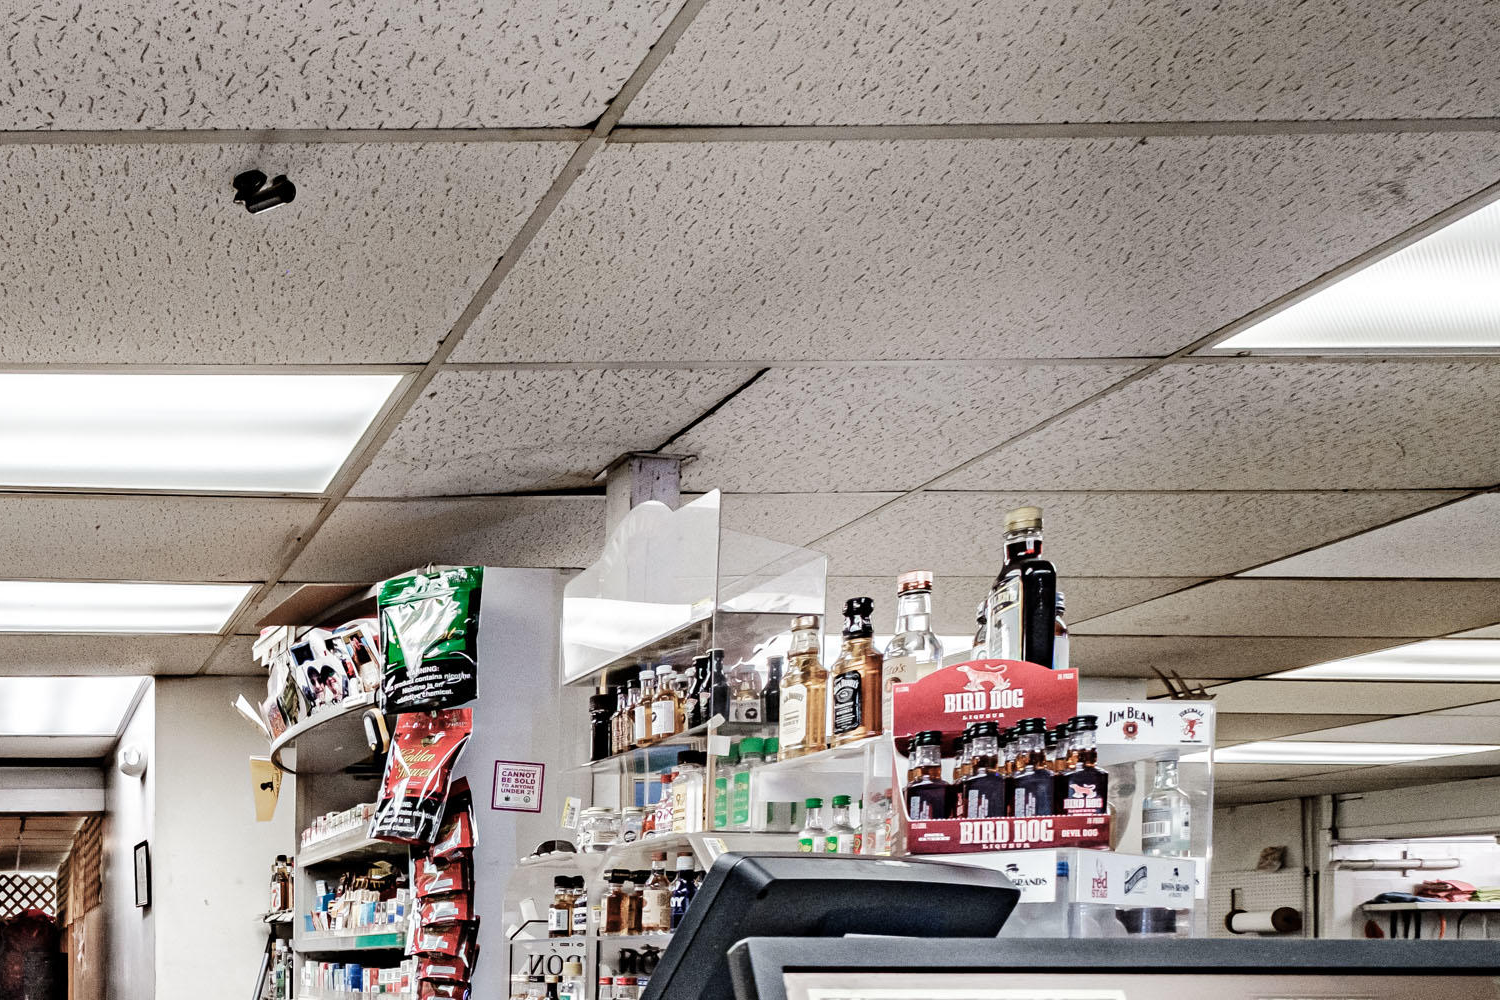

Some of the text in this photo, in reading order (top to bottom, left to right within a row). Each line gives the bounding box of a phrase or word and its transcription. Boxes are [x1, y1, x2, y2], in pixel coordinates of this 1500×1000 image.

[944, 689, 1024, 713] BIRD DOG
[1106, 707, 1155, 727] JIM BEAM
[960, 819, 1054, 844] BIRD DOG
[1092, 872, 1108, 889] red
[1092, 890, 1108, 898] STAG
